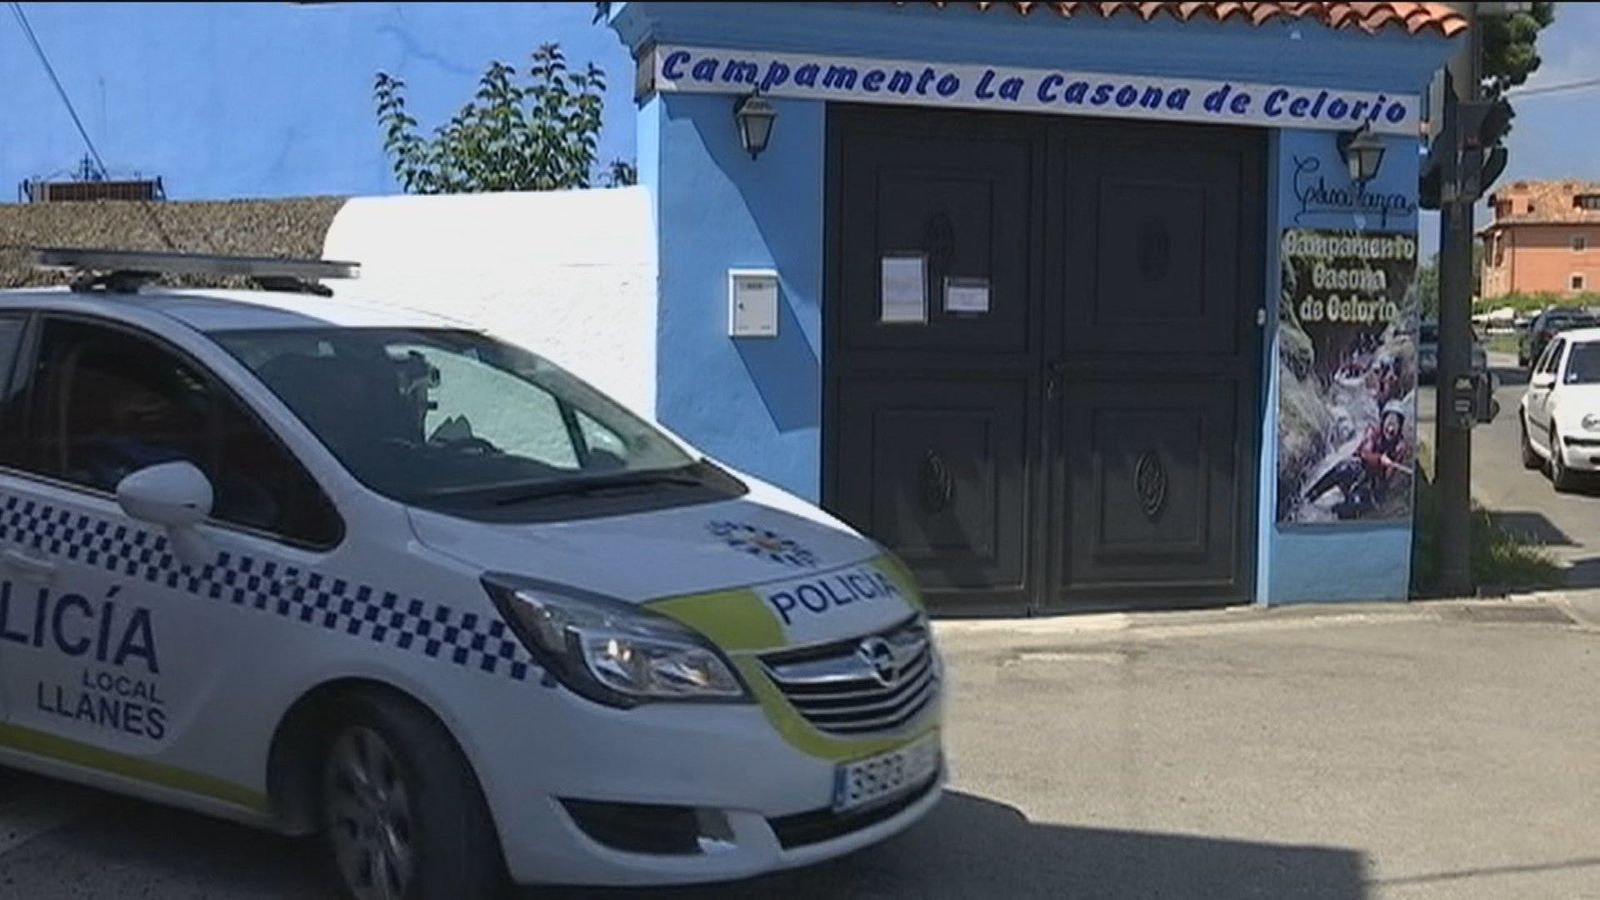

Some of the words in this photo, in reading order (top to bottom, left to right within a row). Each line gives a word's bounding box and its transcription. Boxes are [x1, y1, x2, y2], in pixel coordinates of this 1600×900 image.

[661, 50, 961, 97] Campamento
[974, 69, 1024, 101] La
[1037, 73, 1191, 113] Casona
[1203, 83, 1252, 115] de
[1263, 88, 1407, 124] Celorio
[1282, 228, 1416, 261] Campamento
[1311, 262, 1387, 291] Casona
[1299, 295, 1325, 322] de
[1326, 294, 1398, 325] Celorio
[82, 668, 165, 705] LOCAL
[37, 680, 167, 740] LLANES
